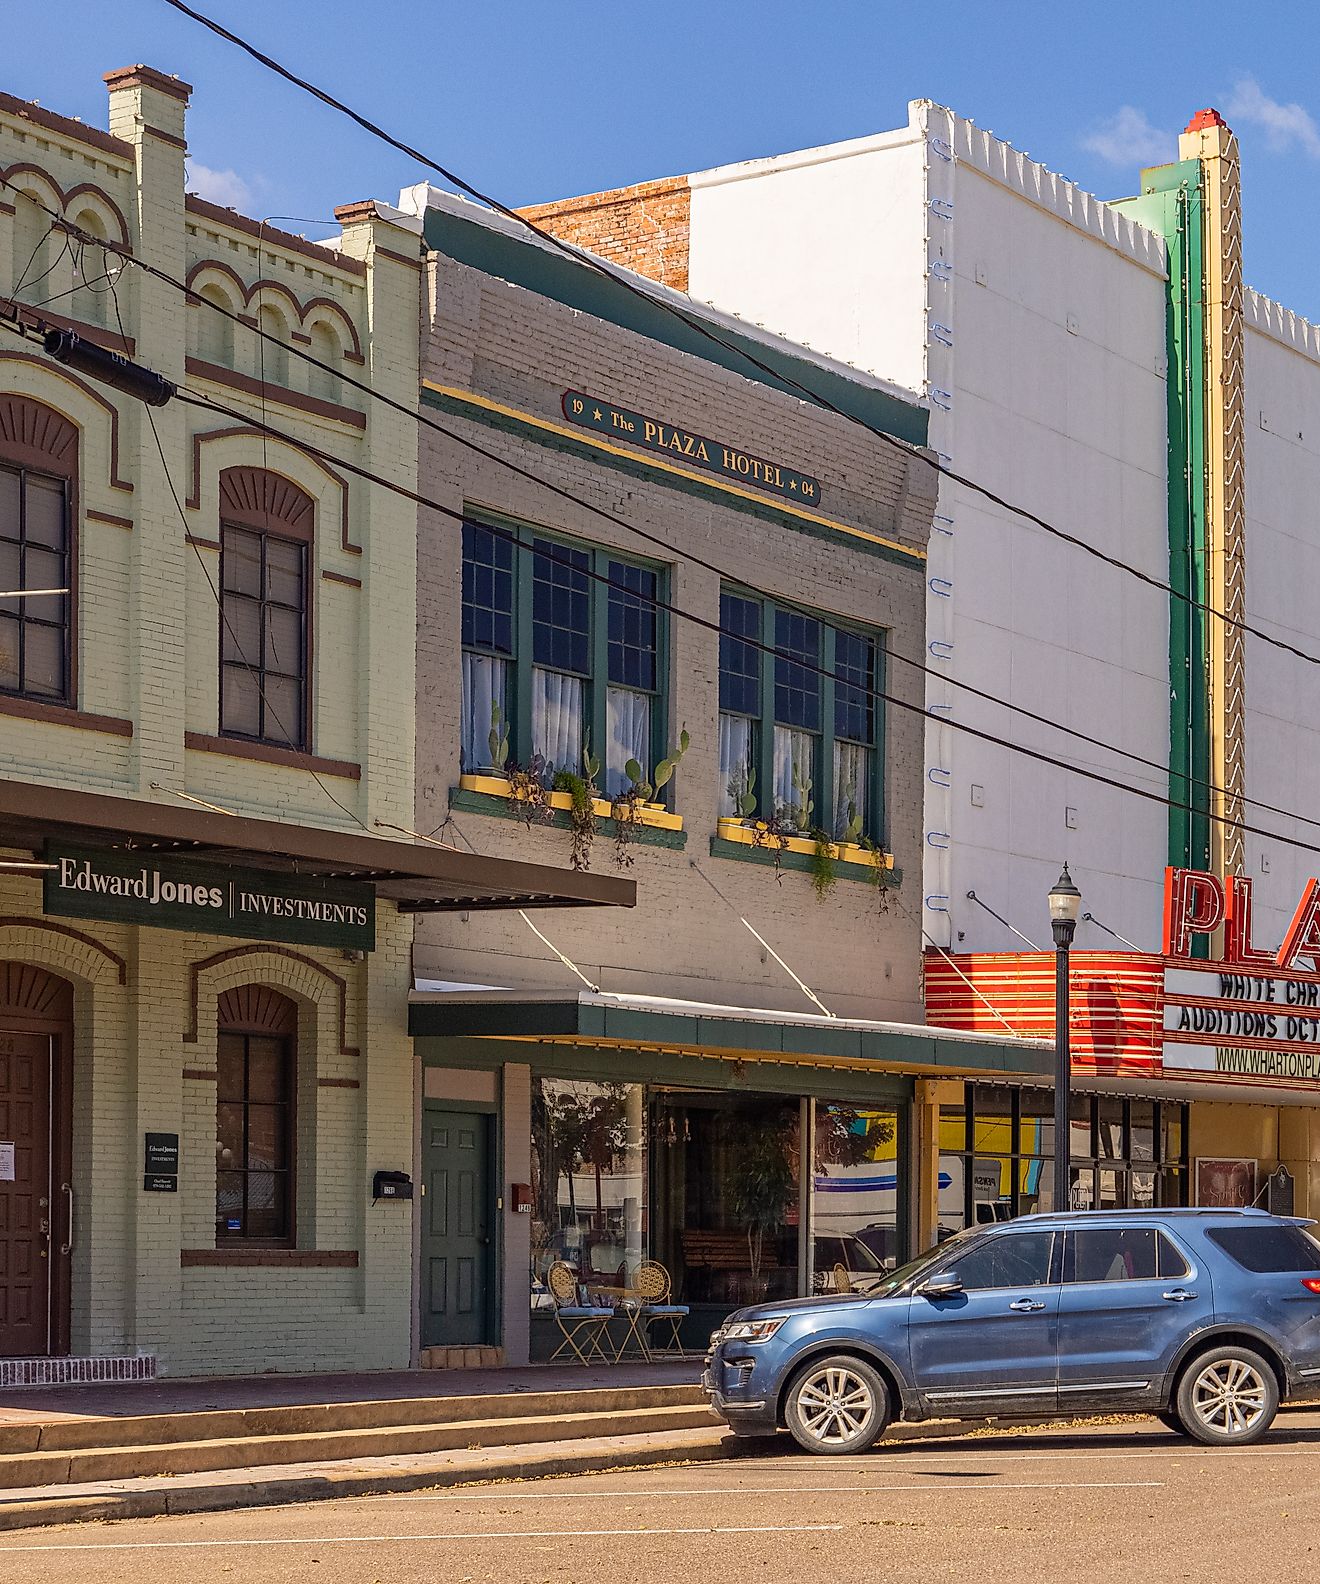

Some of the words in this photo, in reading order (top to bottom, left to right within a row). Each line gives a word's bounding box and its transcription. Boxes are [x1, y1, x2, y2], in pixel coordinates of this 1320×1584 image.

[571, 398, 584, 415] 19
[610, 410, 635, 433] The
[643, 420, 711, 463] PLAZA
[722, 448, 785, 488] HOTEL
[801, 480, 815, 497] 04
[239, 892, 367, 926] INVESTMENTS
[1219, 973, 1276, 1002] WHITE
[1178, 1005, 1278, 1038] AUDITIONS
[1287, 1015, 1319, 1041] OCT
